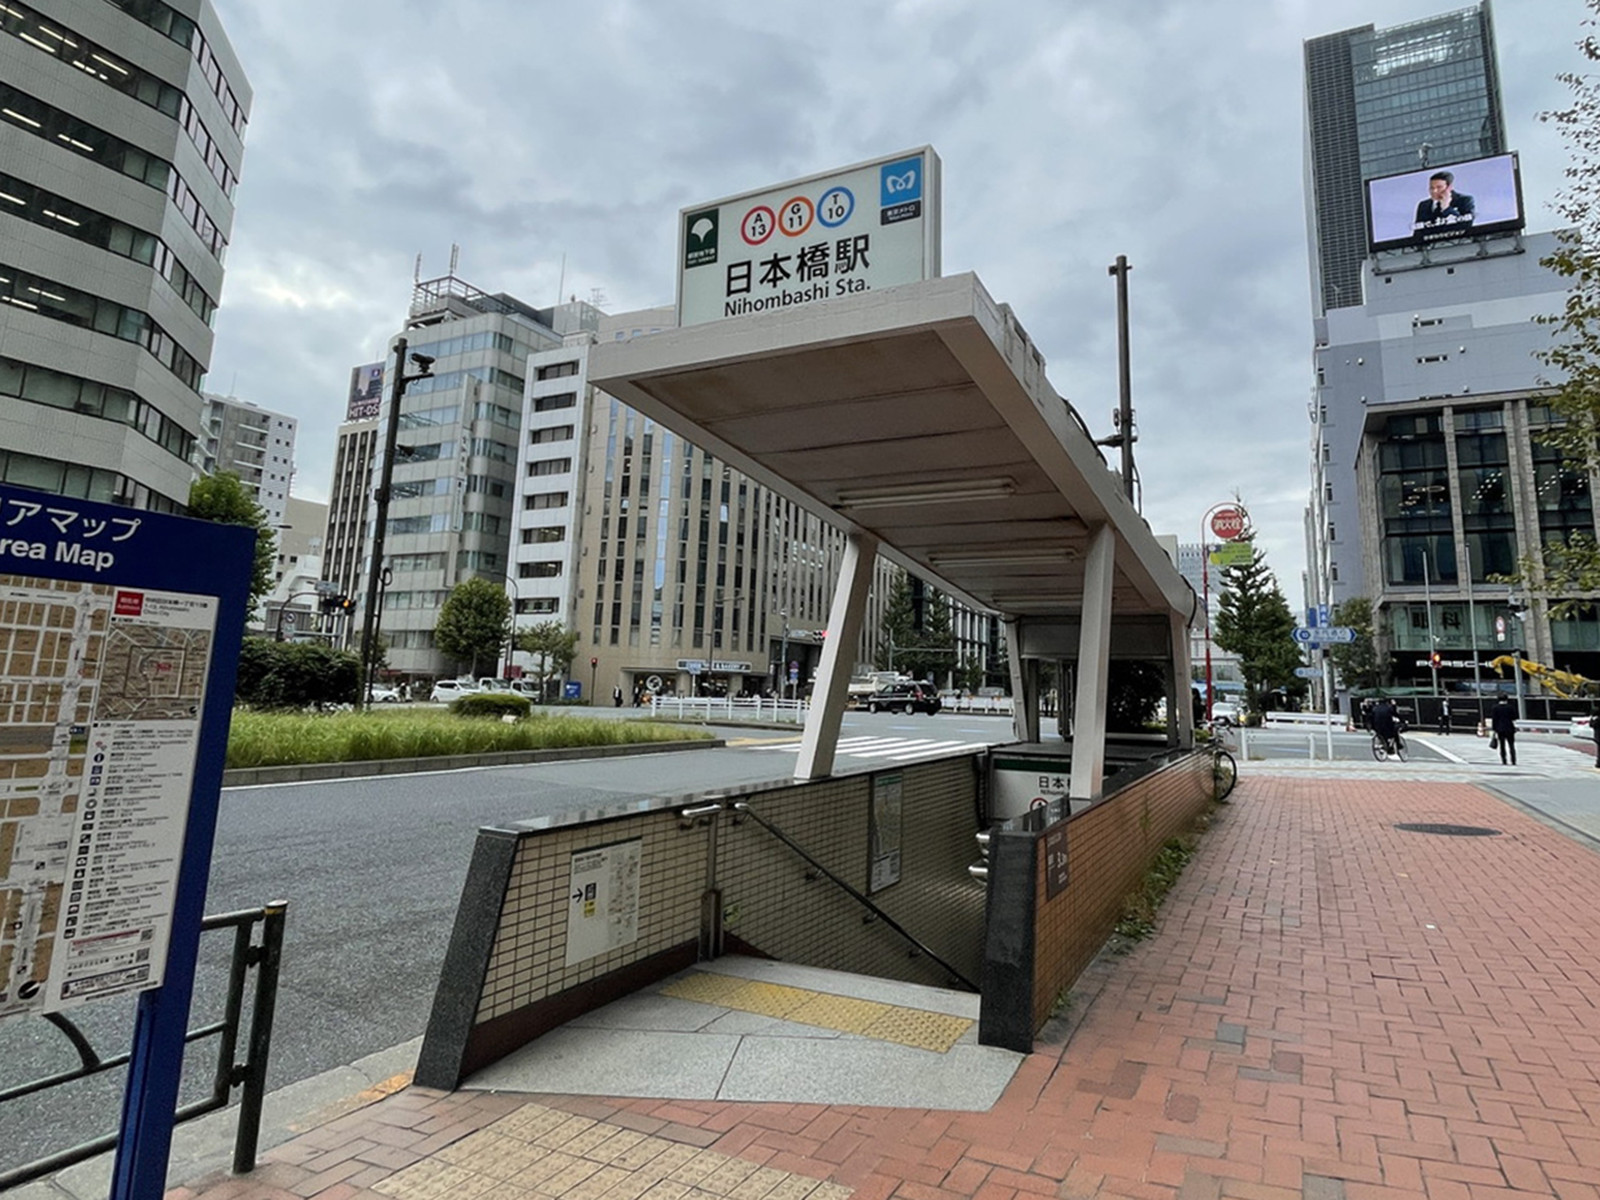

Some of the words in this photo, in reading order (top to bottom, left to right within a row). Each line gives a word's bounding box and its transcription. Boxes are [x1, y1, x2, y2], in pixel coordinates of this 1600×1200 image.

[832, 194, 840, 205] T
[791, 203, 801, 215] G
[827, 205, 844, 219] 10
[753, 213, 764, 224] A
[789, 215, 803, 228] 11
[751, 223, 767, 237] 13
[726, 234, 870, 297] 日本橋駅
[724, 281, 830, 317] Nihombashi
[836, 277, 871, 296] Sta.
[0, 497, 142, 542] アマップ
[0, 538, 47, 560] rea
[55, 541, 115, 572] Map
